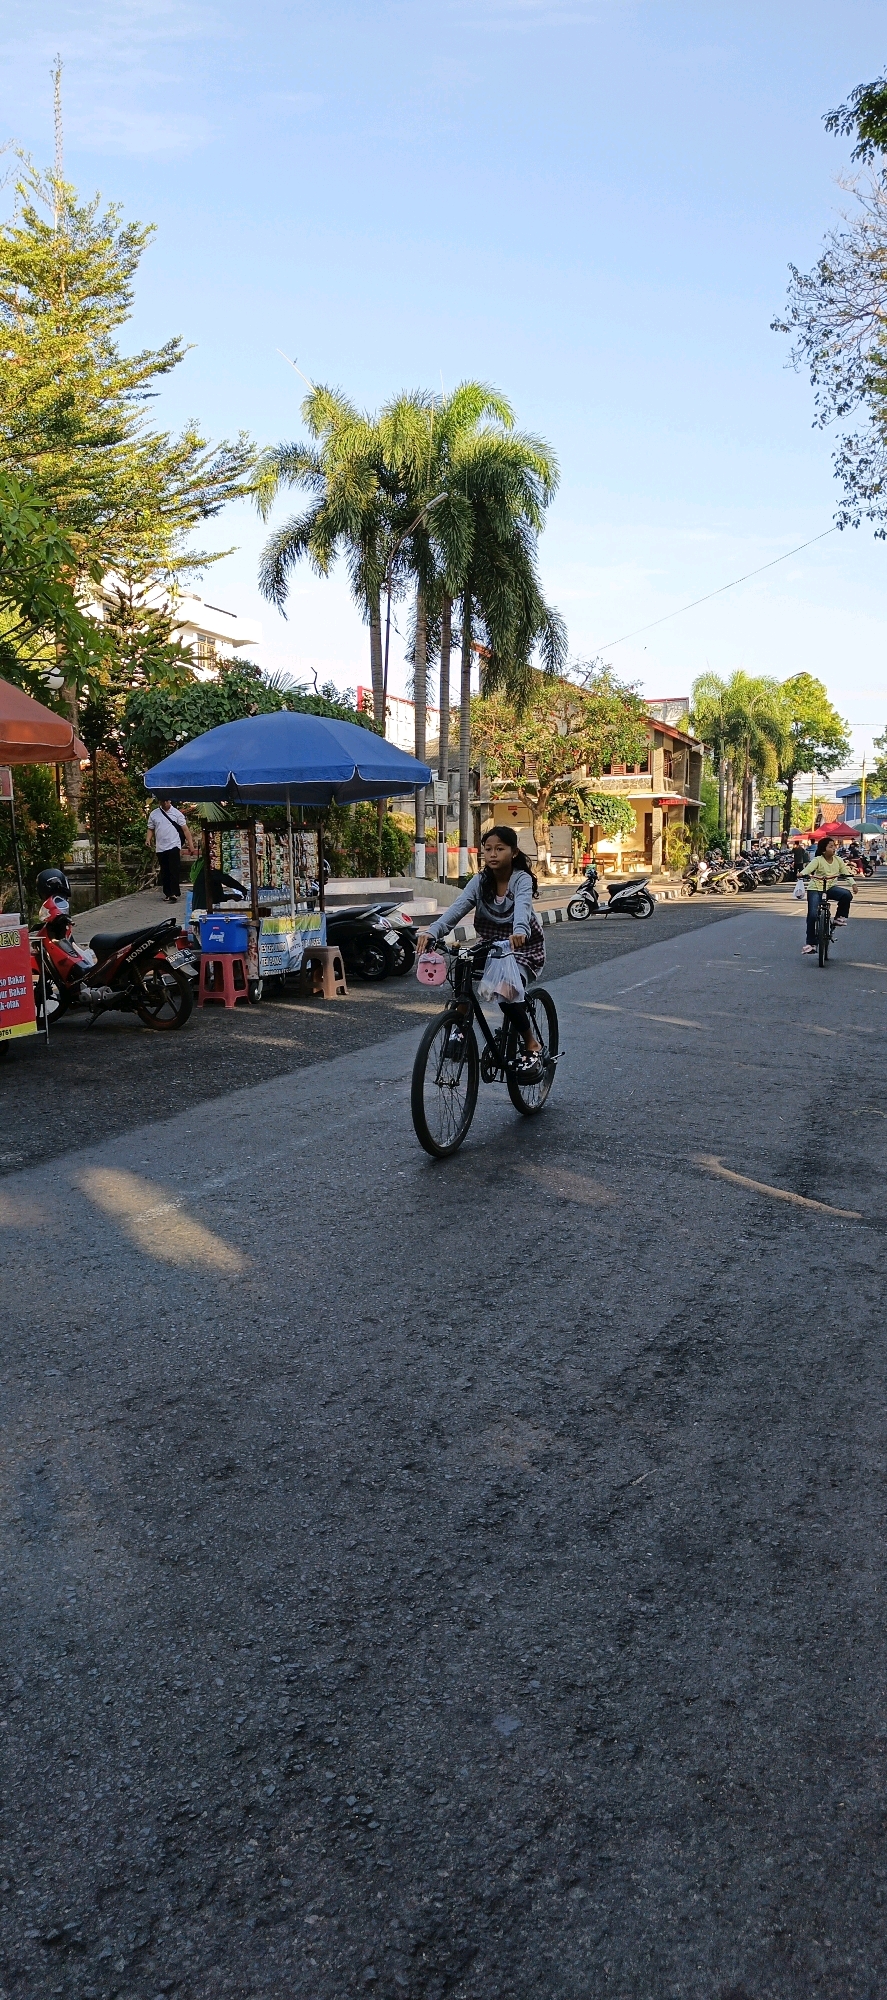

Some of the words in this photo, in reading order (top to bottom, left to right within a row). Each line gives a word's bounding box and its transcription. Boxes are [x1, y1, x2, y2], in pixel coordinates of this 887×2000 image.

[125, 939, 156, 963] HONDA
[7, 975, 26, 986] Bakar
[8, 987, 27, 997] Bakar
